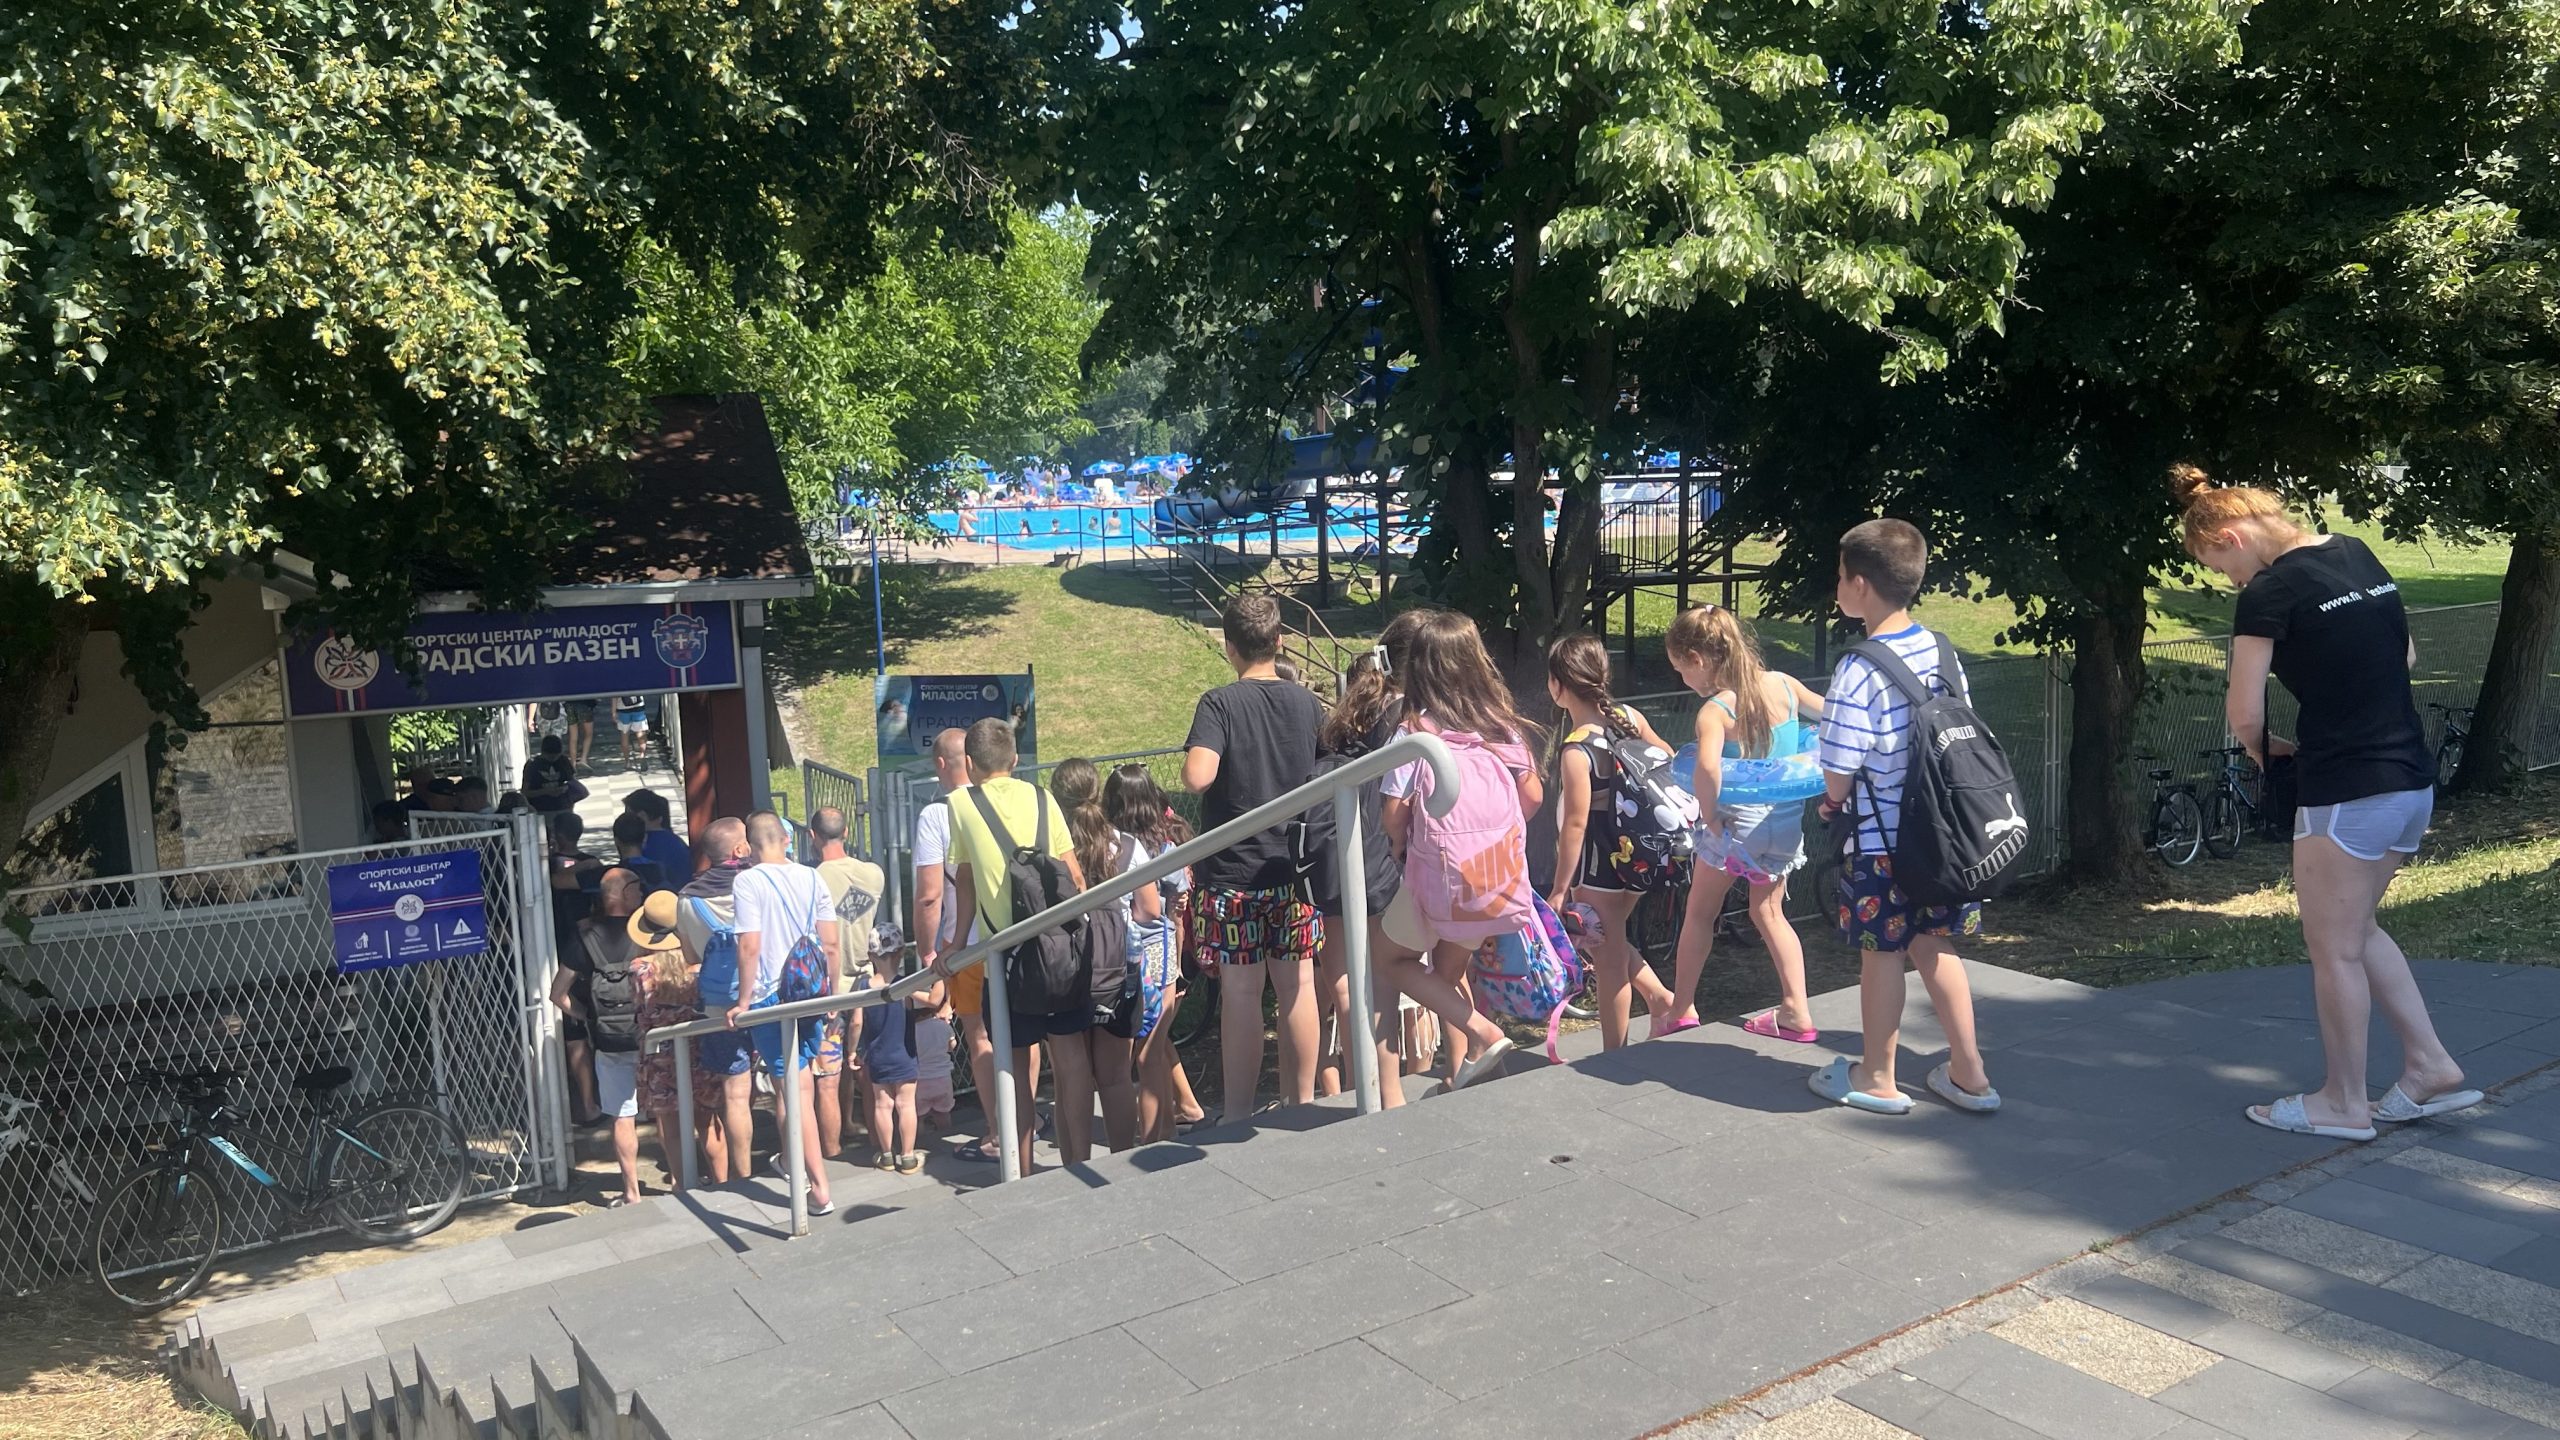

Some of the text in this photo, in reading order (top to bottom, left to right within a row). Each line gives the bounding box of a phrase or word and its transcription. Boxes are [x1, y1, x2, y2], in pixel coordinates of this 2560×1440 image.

[402, 632, 479, 648] ПОРТСКИ
[482, 628, 543, 645] ЦЕНТАР
[395, 637, 641, 675] РАДСКИ БАЗЕН
[921, 690, 979, 702] МЛАДОСТ
[1963, 828, 2027, 891] PUMA
[359, 861, 451, 880] СПОРТСКИ ЦЕНТАР
